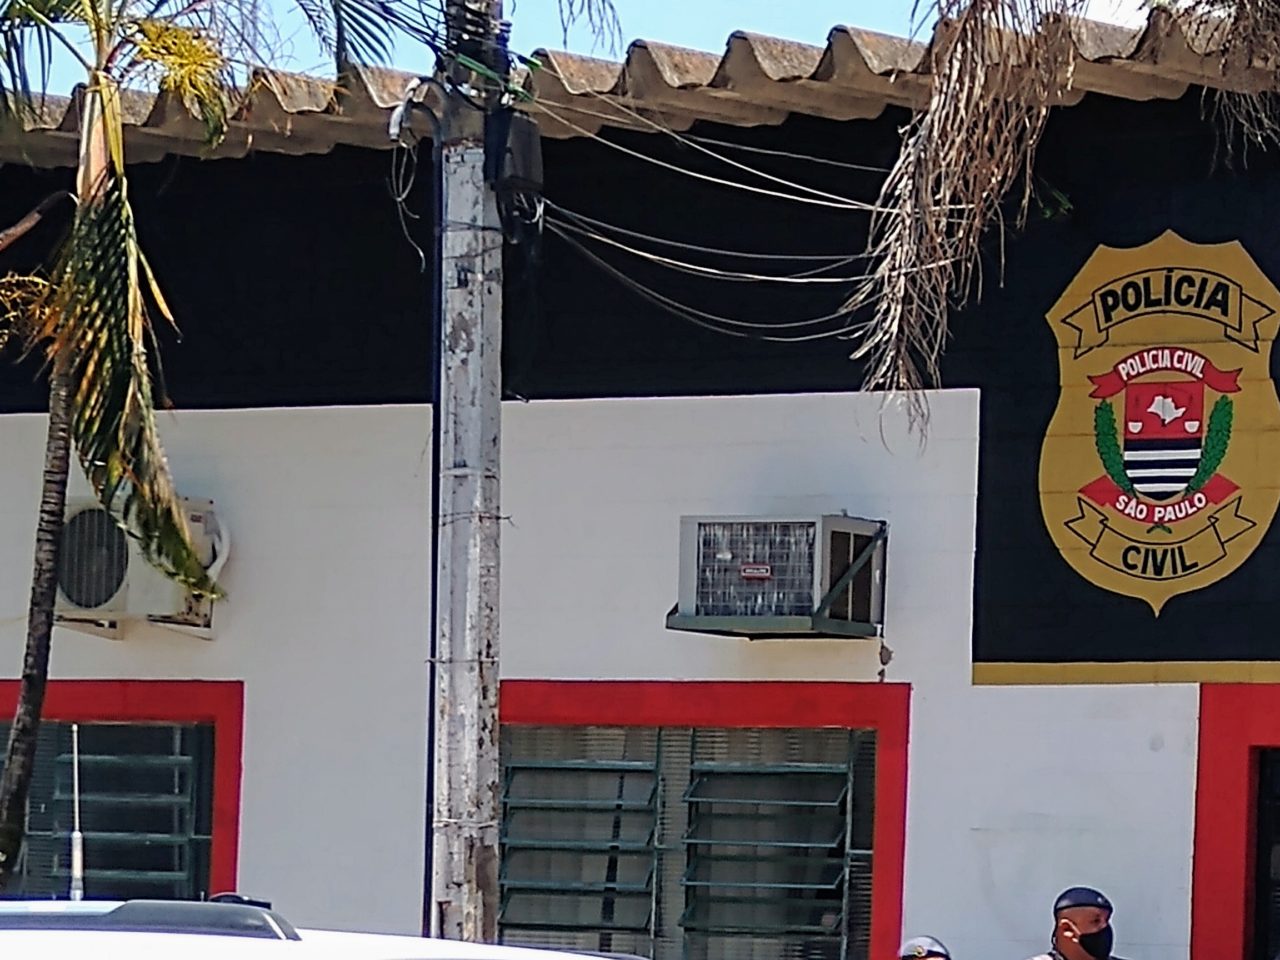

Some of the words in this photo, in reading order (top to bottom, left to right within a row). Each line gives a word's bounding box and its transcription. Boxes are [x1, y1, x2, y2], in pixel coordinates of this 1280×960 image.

[1099, 269, 1230, 324] POLÍCIA
[1118, 349, 1171, 381] POLICIA
[1173, 350, 1206, 379] CIVIL
[1153, 493, 1207, 522] PAULO
[1121, 544, 1199, 577] CIVIL
